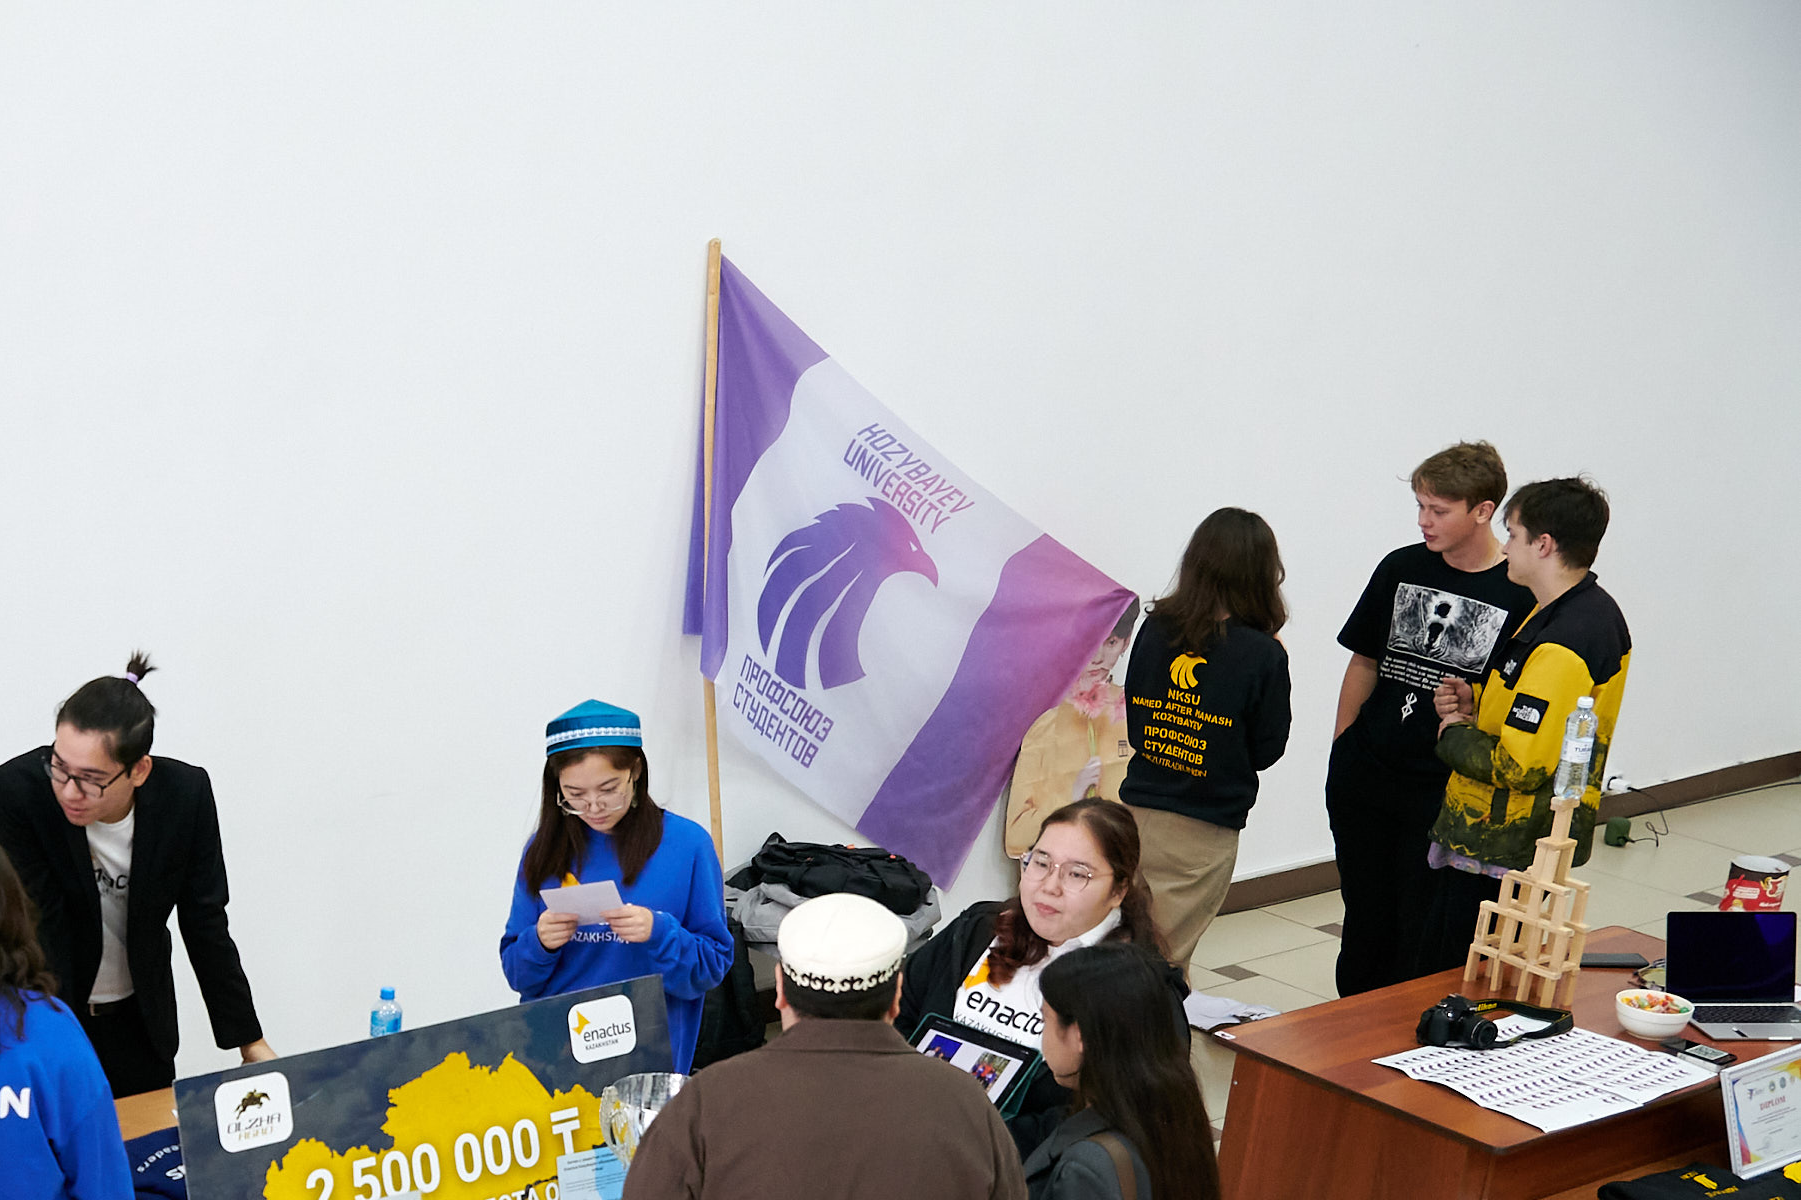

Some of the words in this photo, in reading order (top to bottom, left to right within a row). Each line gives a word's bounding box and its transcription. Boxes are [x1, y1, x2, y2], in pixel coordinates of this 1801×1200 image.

[857, 423, 975, 513] KOZYBAYEV
[843, 439, 951, 534] UNIVERSITY
[740, 653, 835, 743] ПРОФСОЮЗ
[1132, 696, 1162, 709] NAMED
[1165, 702, 1193, 716] AFTER
[1195, 709, 1233, 727] MANASH
[1167, 688, 1201, 706] NKSU
[733, 682, 819, 769] СТУДЕНТОВ
[1152, 711, 1203, 731] KOZYBAYEV
[1144, 725, 1207, 751] ПРОФСОЮЗ
[1144, 740, 1204, 765] СТУДЕНТОВ
[584, 1022, 632, 1042] enactus
[454, 1118, 541, 1183] 000
